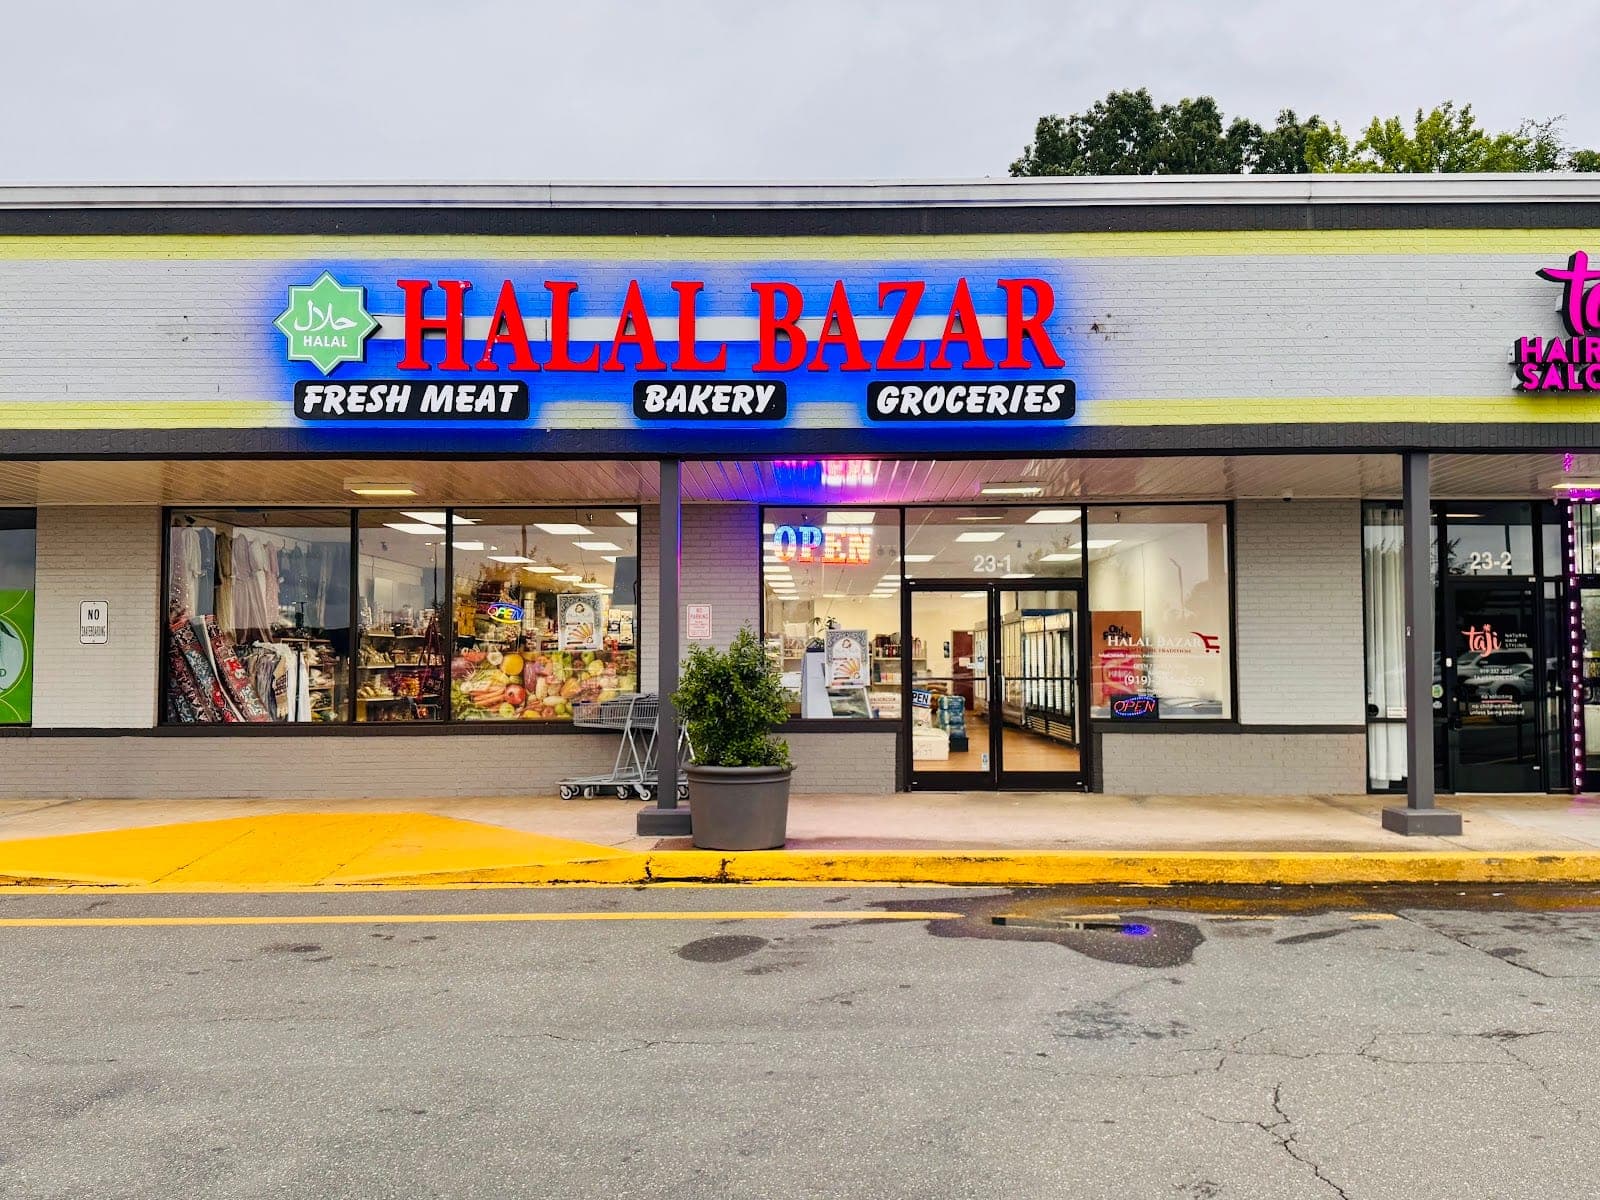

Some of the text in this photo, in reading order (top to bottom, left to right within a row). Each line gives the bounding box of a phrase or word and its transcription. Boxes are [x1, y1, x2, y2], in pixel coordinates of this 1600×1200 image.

[294, 300, 358, 332] حلال
[397, 277, 1066, 372] HALAL BAZAR
[302, 336, 348, 348] HALAL
[302, 385, 519, 415] FRESH MEAT
[644, 385, 776, 416] BAKERY
[876, 384, 1066, 416] GROCERIES
[774, 525, 872, 565] OPEN
[973, 554, 1012, 573] 23-1
[1470, 551, 1512, 570] 23-2
[88, 609, 100, 620] NO
[488, 606, 523, 620] OPEN
[1107, 635, 1202, 647] HALAL BAZAR
[1461, 624, 1502, 657] taji
[1114, 700, 1156, 713] OPEN
